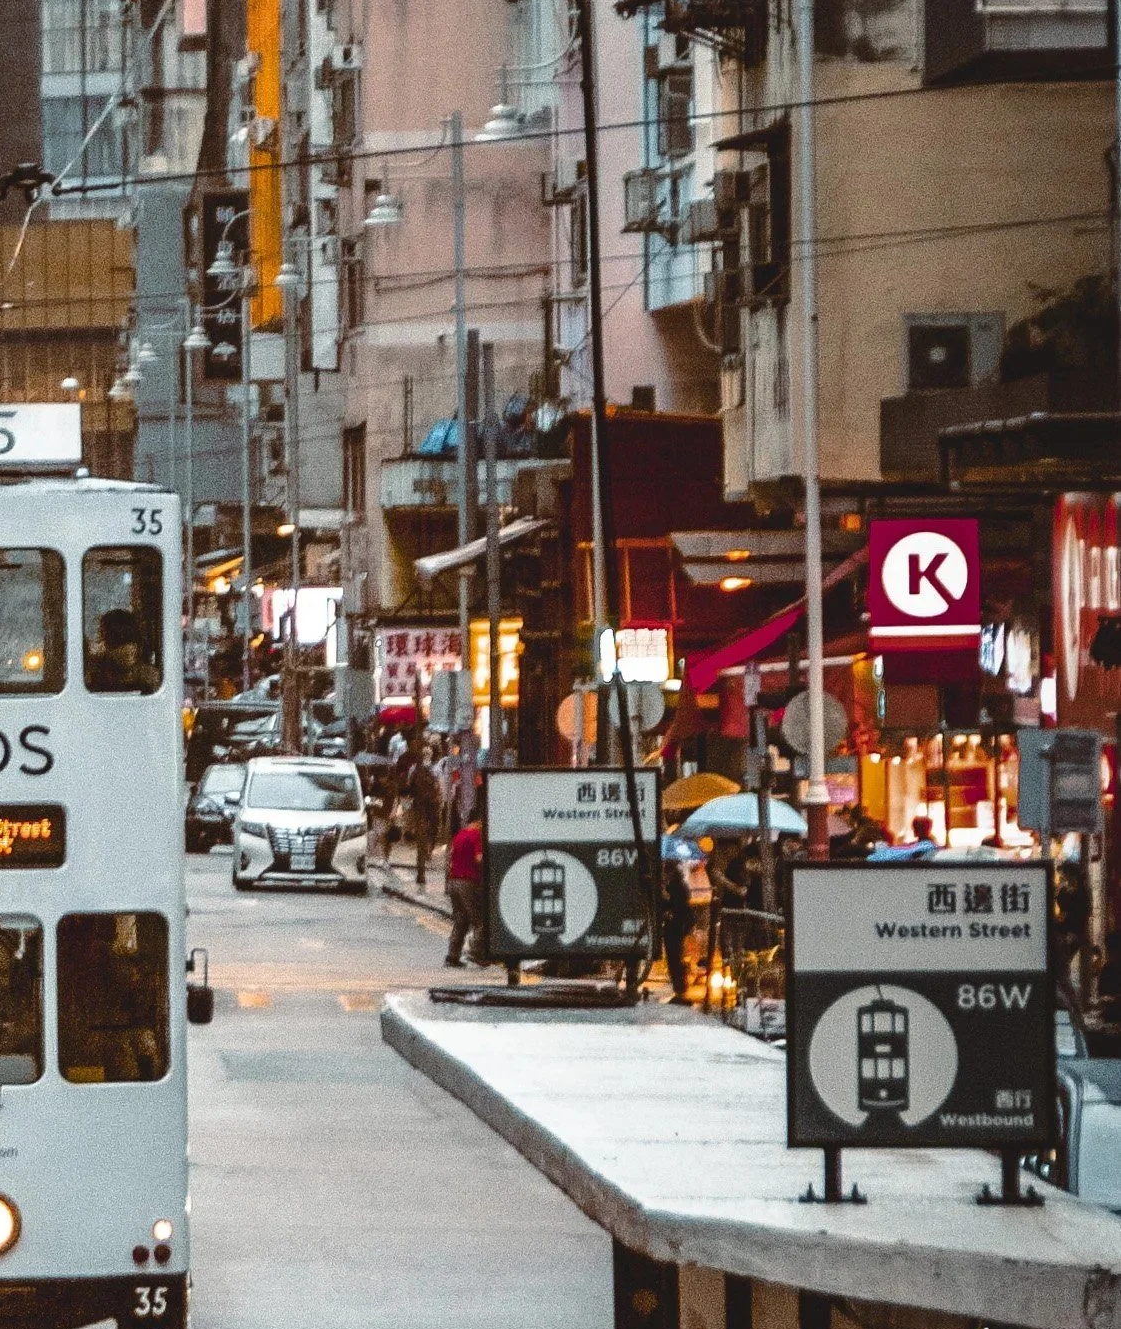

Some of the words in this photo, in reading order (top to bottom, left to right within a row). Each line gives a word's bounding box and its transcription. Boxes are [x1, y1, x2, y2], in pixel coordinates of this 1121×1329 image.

[131, 508, 163, 536] 35
[908, 553, 957, 607] K
[543, 808, 600, 819] Western
[605, 808, 646, 819] Stret
[927, 884, 1031, 914] 西邊街
[875, 922, 962, 938] Western
[969, 922, 1031, 938] Street
[957, 984, 1032, 1009] 86W
[939, 1113, 1034, 1127] Westbound
[134, 1287, 168, 1317] 35
